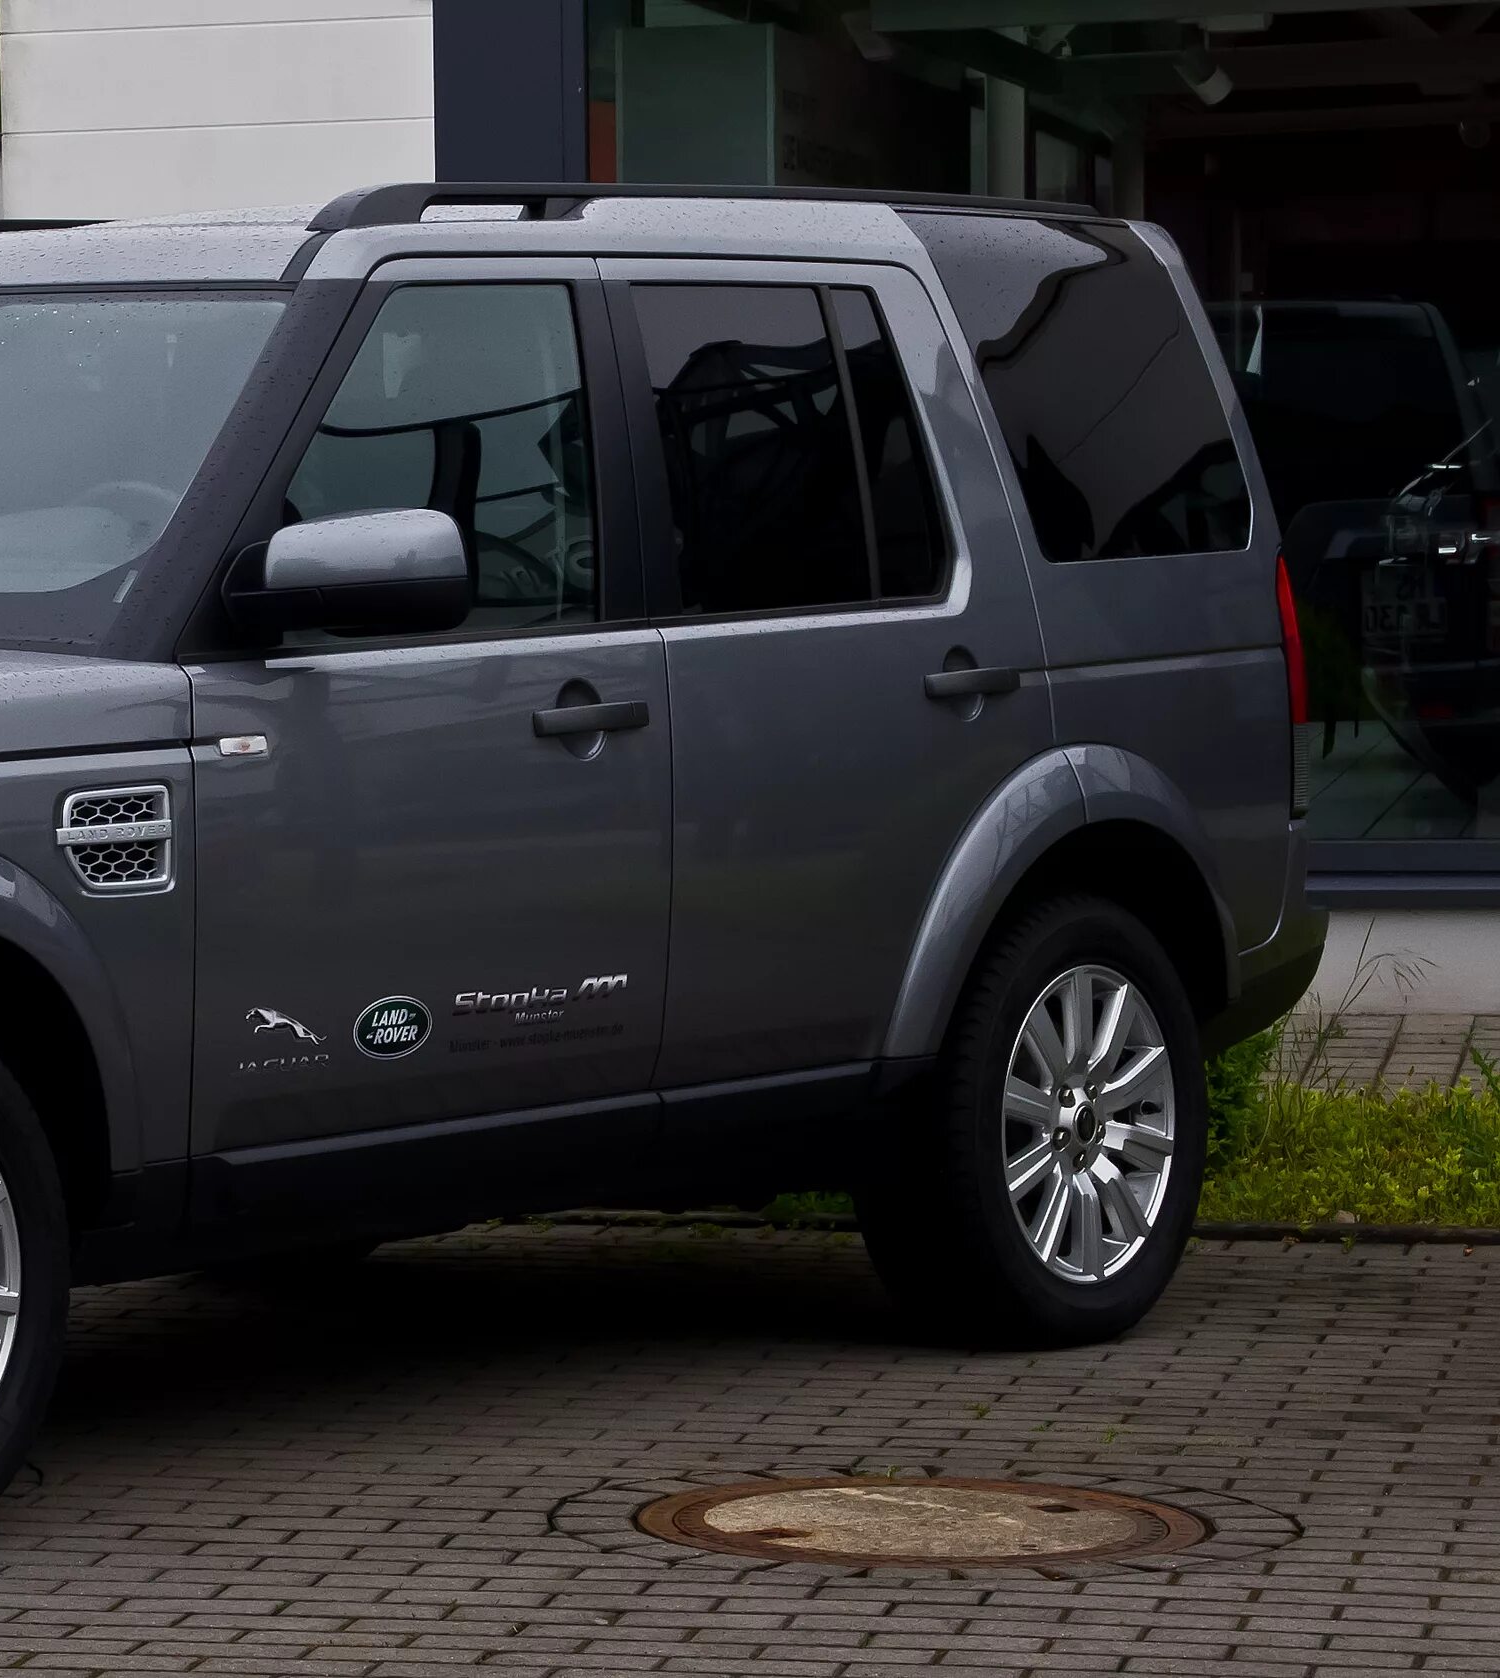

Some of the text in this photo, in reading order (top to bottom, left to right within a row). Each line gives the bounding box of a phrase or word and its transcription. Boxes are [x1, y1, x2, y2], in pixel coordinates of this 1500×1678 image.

[66, 824, 167, 842] LAND ROVER
[372, 1009, 408, 1027] LAND
[373, 1025, 418, 1045] ROVER
